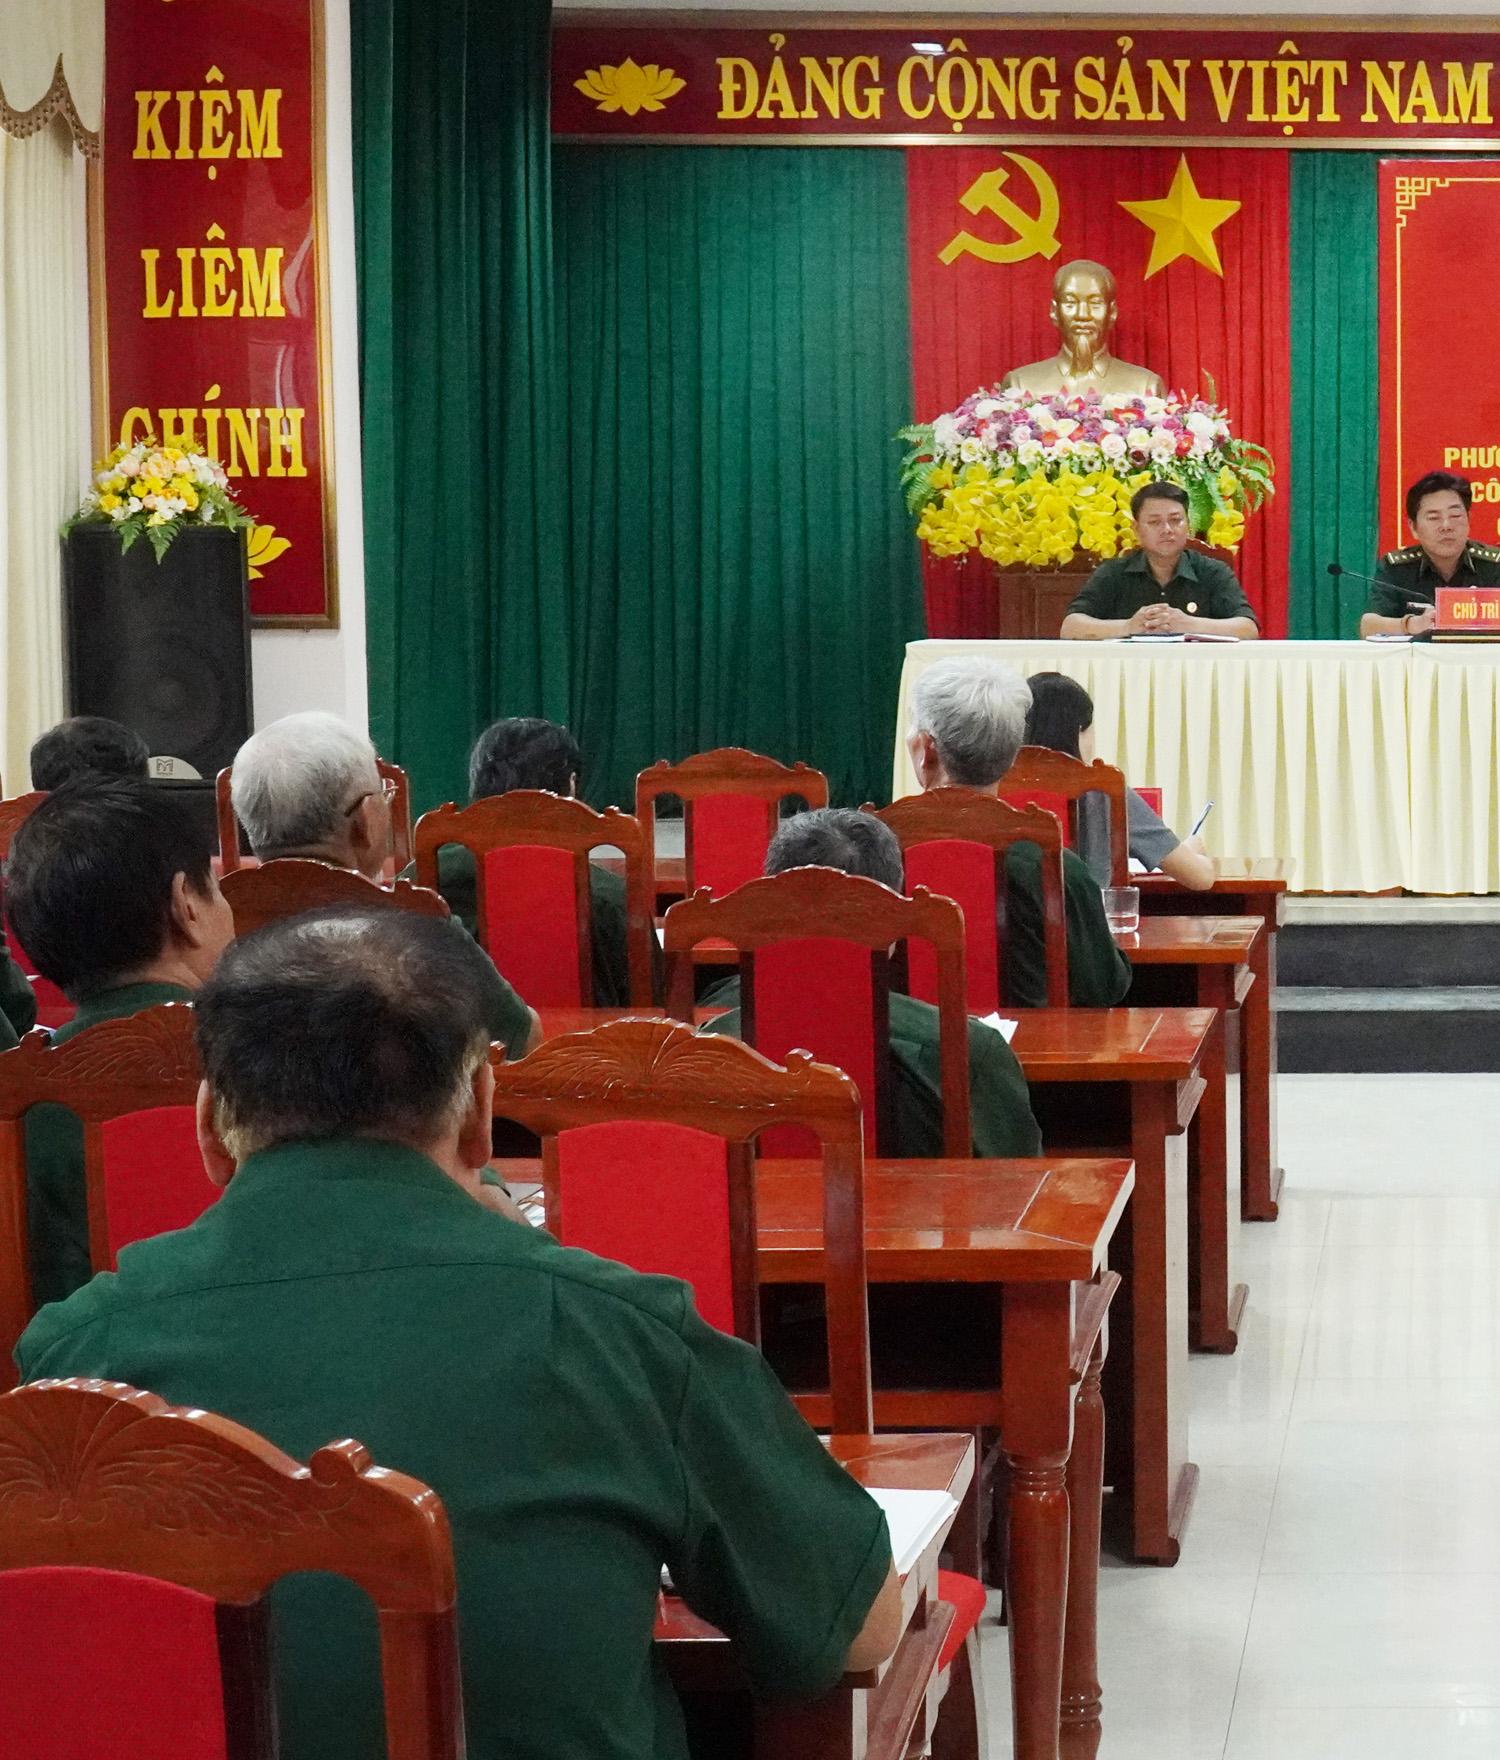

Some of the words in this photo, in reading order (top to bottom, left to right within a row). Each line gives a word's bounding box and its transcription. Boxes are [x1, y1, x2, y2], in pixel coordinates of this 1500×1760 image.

[133, 66, 283, 180] KIỆM
[717, 34, 884, 121] ĐẢNG
[898, 38, 1059, 132] CỘNG
[1074, 37, 1189, 122] SẢN
[1203, 40, 1347, 135] VIỆT
[1361, 60, 1493, 124] NAM
[141, 223, 286, 318] LIÊM
[1453, 597, 1477, 620] CHỦ
[1481, 599, 1500, 619] TRÌ
